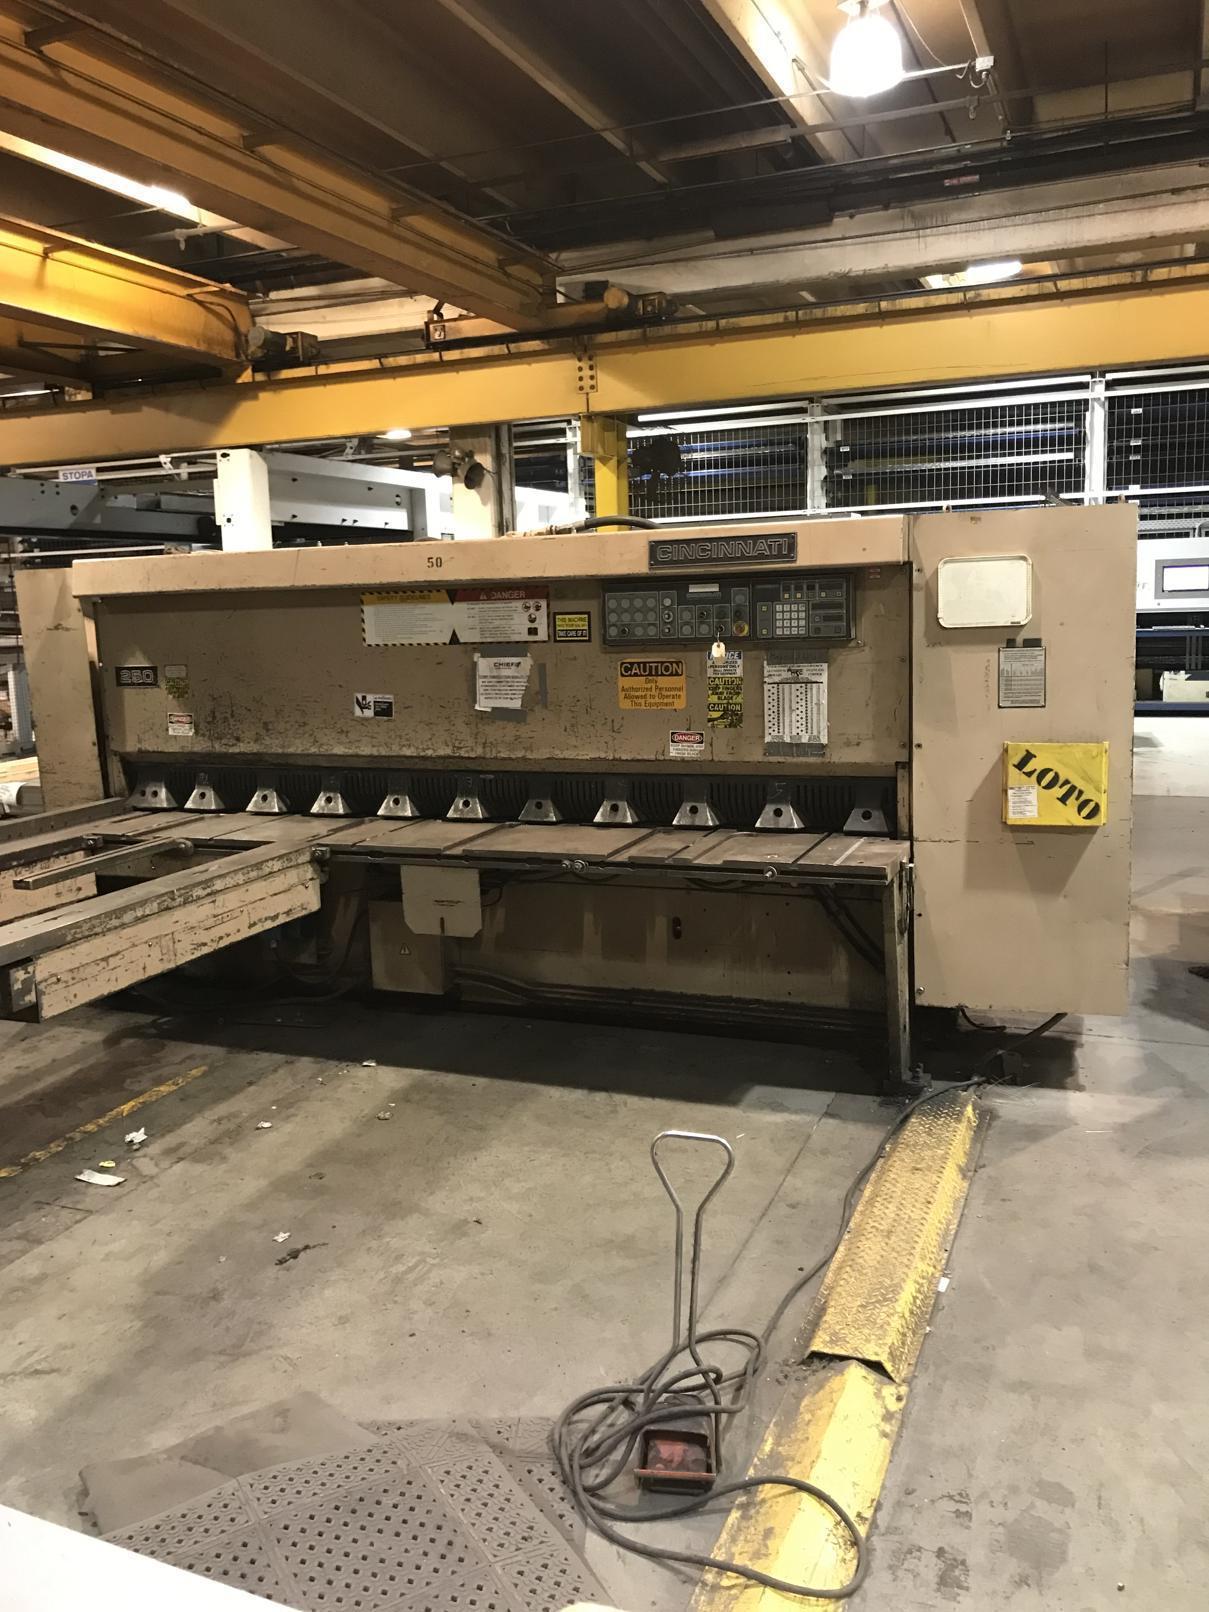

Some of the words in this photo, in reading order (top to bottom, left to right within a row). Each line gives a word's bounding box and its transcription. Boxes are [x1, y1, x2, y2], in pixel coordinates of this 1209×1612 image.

[62, 470, 94, 480] STOPA
[656, 538, 789, 561] CINCINNATI
[427, 556, 443, 568] 50
[490, 590, 526, 599] DANGER
[621, 662, 682, 676] CAUTION
[120, 670, 154, 683] 250
[645, 677, 658, 685] Only
[658, 692, 682, 701] Operate
[644, 700, 675, 708] Equipment
[709, 703, 741, 711] CAUTION
[1012, 749, 1100, 820] LOTO
